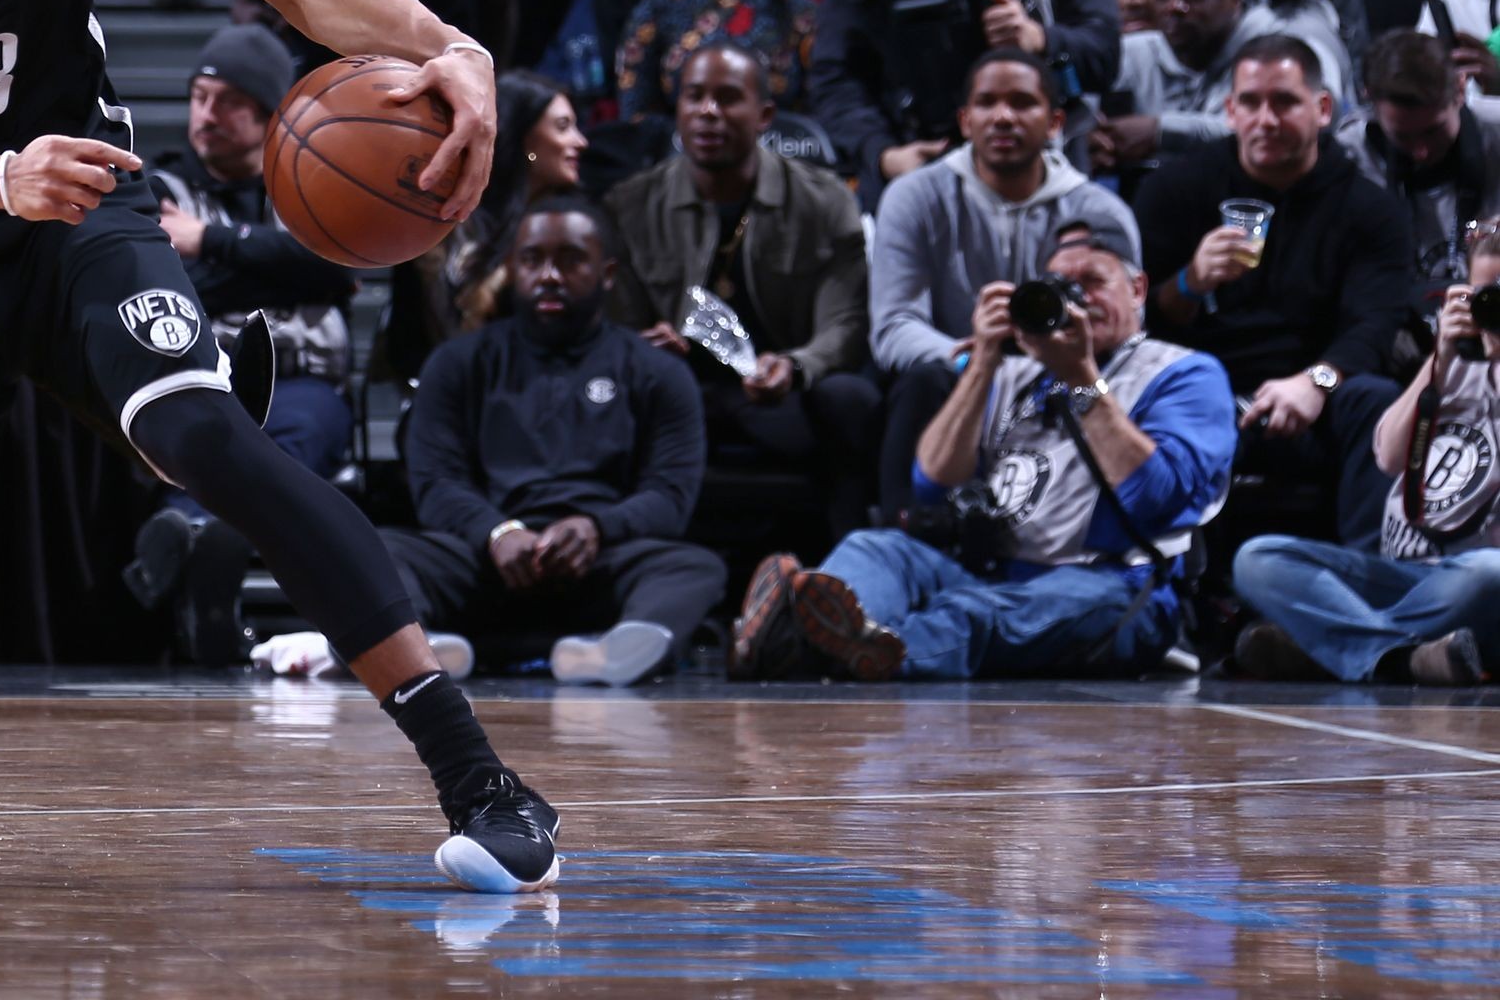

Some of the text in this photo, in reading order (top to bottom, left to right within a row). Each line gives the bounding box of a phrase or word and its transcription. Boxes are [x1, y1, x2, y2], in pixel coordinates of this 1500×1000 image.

[125, 293, 197, 330] NETS
[162, 322, 180, 346] B
[1425, 446, 1462, 490] B
